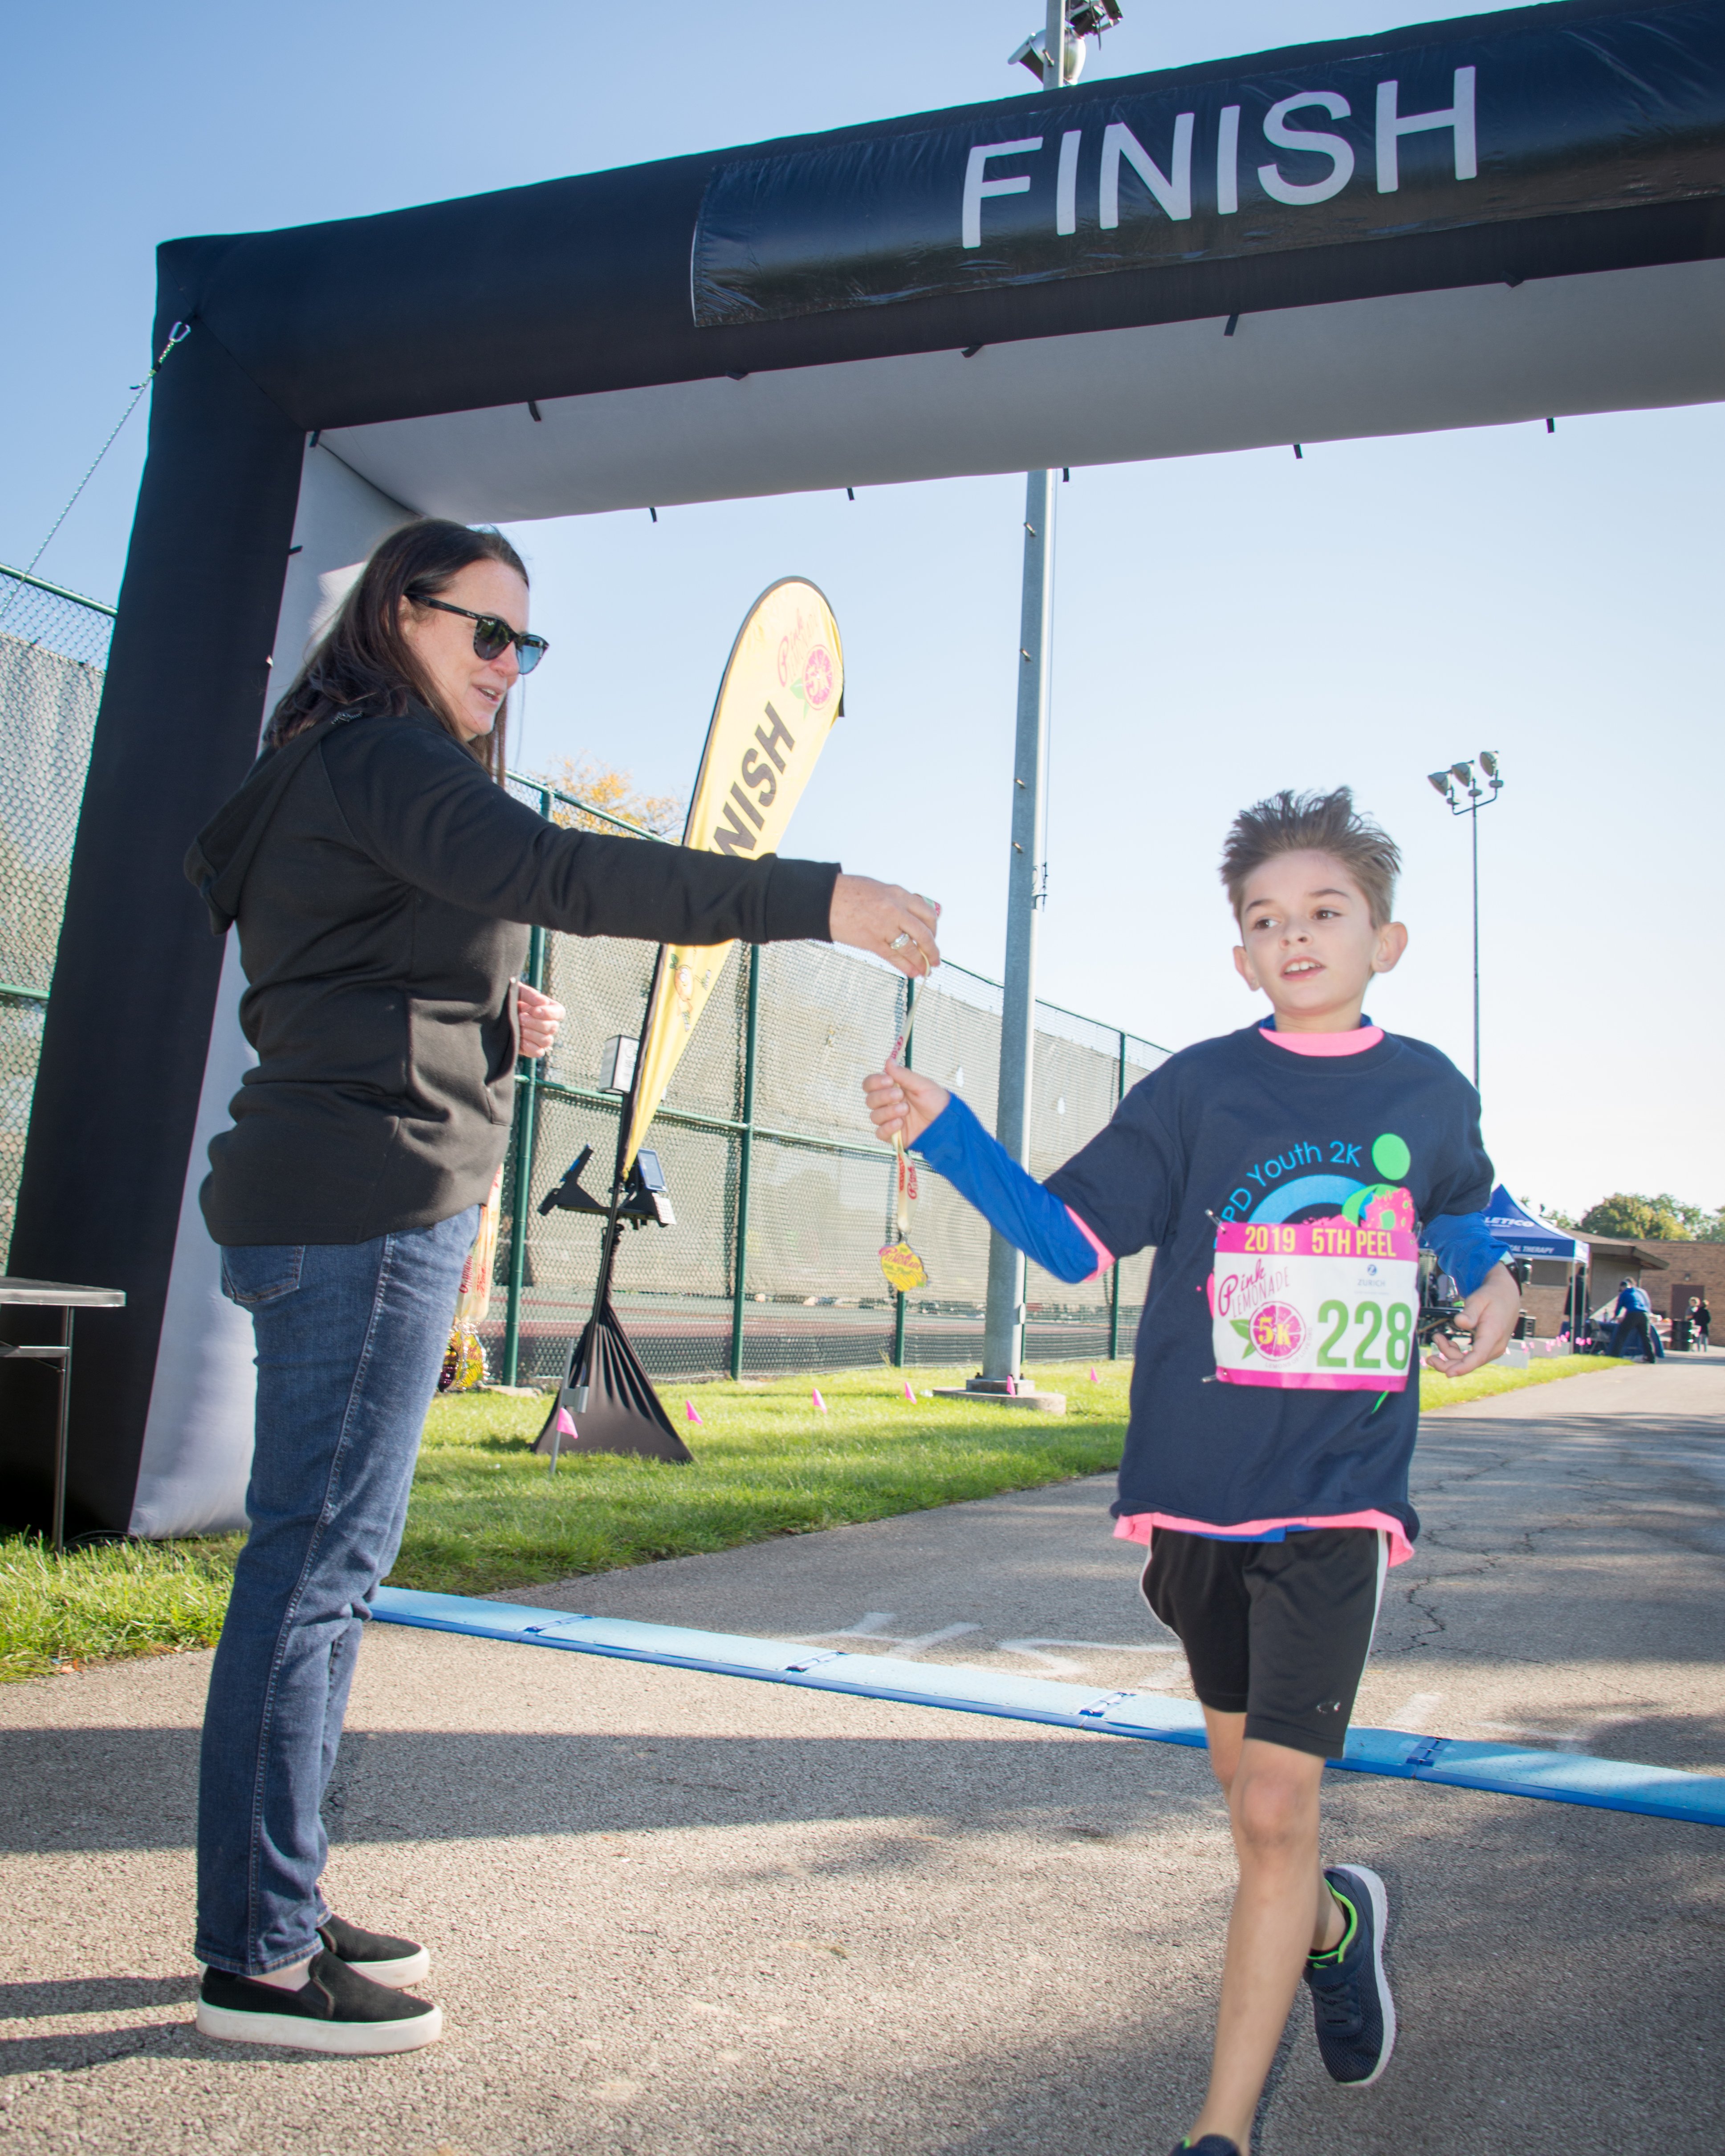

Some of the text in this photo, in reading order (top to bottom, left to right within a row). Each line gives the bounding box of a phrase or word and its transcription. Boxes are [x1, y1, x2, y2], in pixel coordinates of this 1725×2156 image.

[962, 65, 1477, 249] FINISH
[1246, 1141, 1322, 1187] Youth
[1329, 1140, 1363, 1168] 2K
[1245, 1226, 1397, 1258] 2019 5TH PEEL
[1218, 1258, 1266, 1317] Pink
[1231, 1266, 1290, 1318] LEMONADE
[1357, 1279, 1387, 1287] ZURICH
[1258, 1316, 1291, 1345] 5K
[1316, 1299, 1412, 1371] 228
